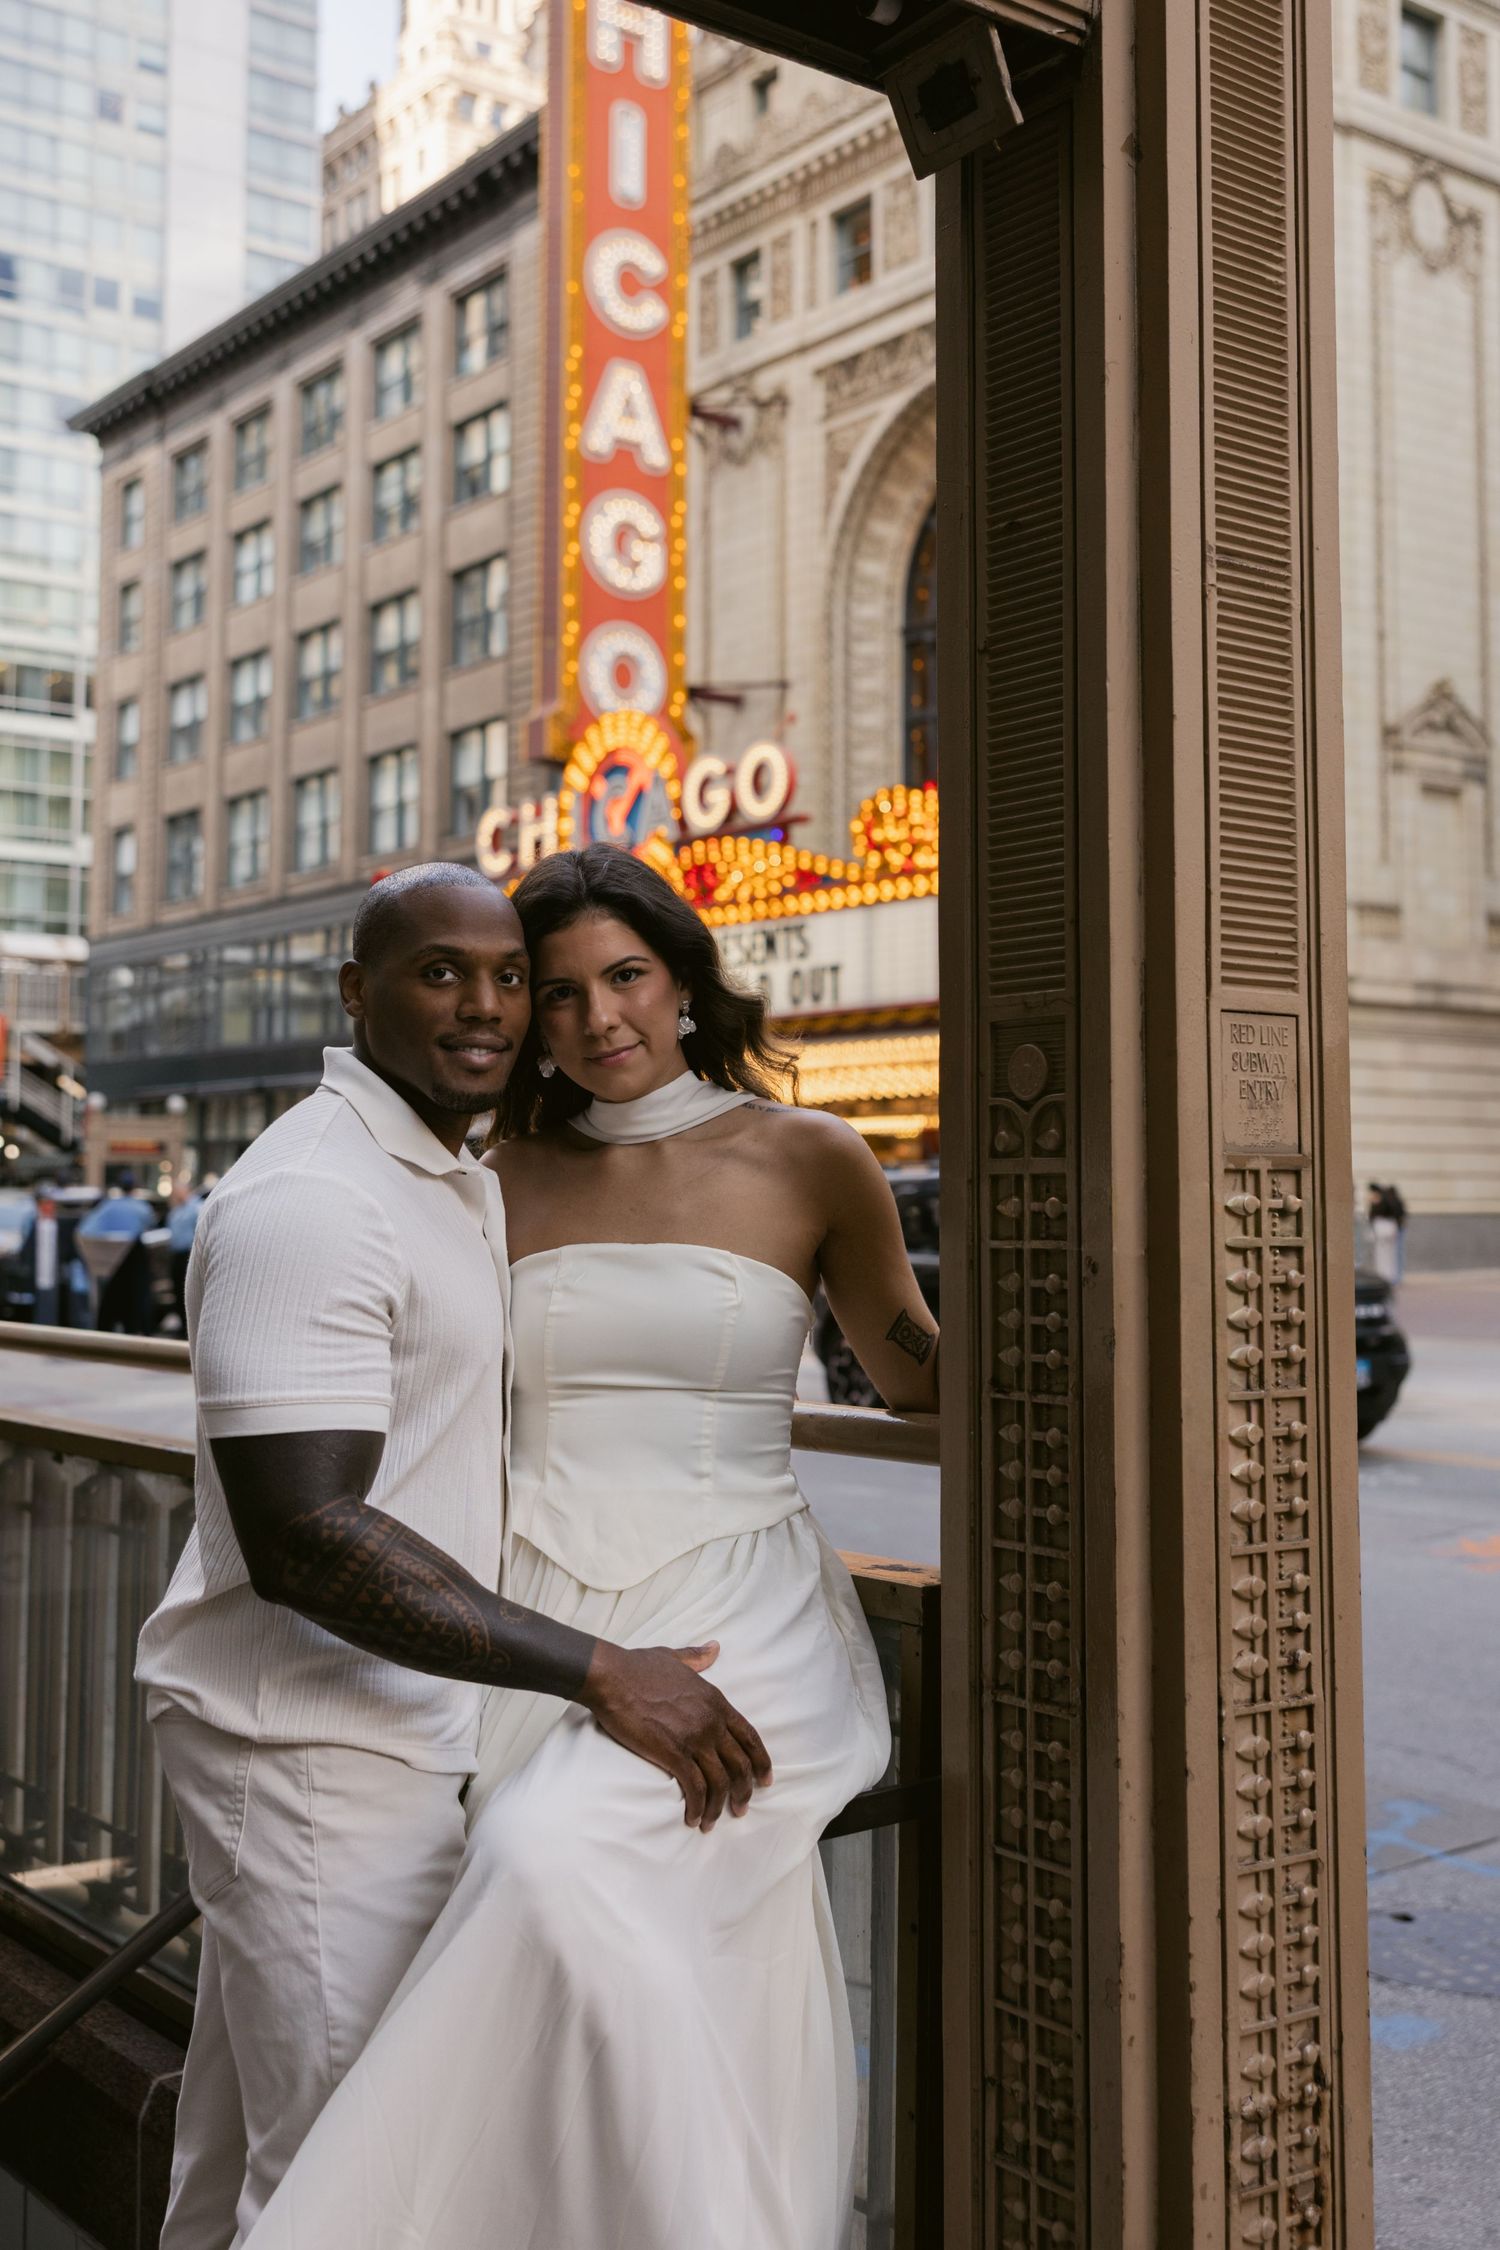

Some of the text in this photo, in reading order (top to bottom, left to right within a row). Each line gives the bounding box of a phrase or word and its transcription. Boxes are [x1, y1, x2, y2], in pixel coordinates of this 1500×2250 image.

[790, 965, 840, 1005] OUT
[1230, 1023, 1289, 1047] RED LINE
[1231, 1051, 1287, 1074] SUBWAY
[1239, 1079, 1286, 1101] ENTRY
